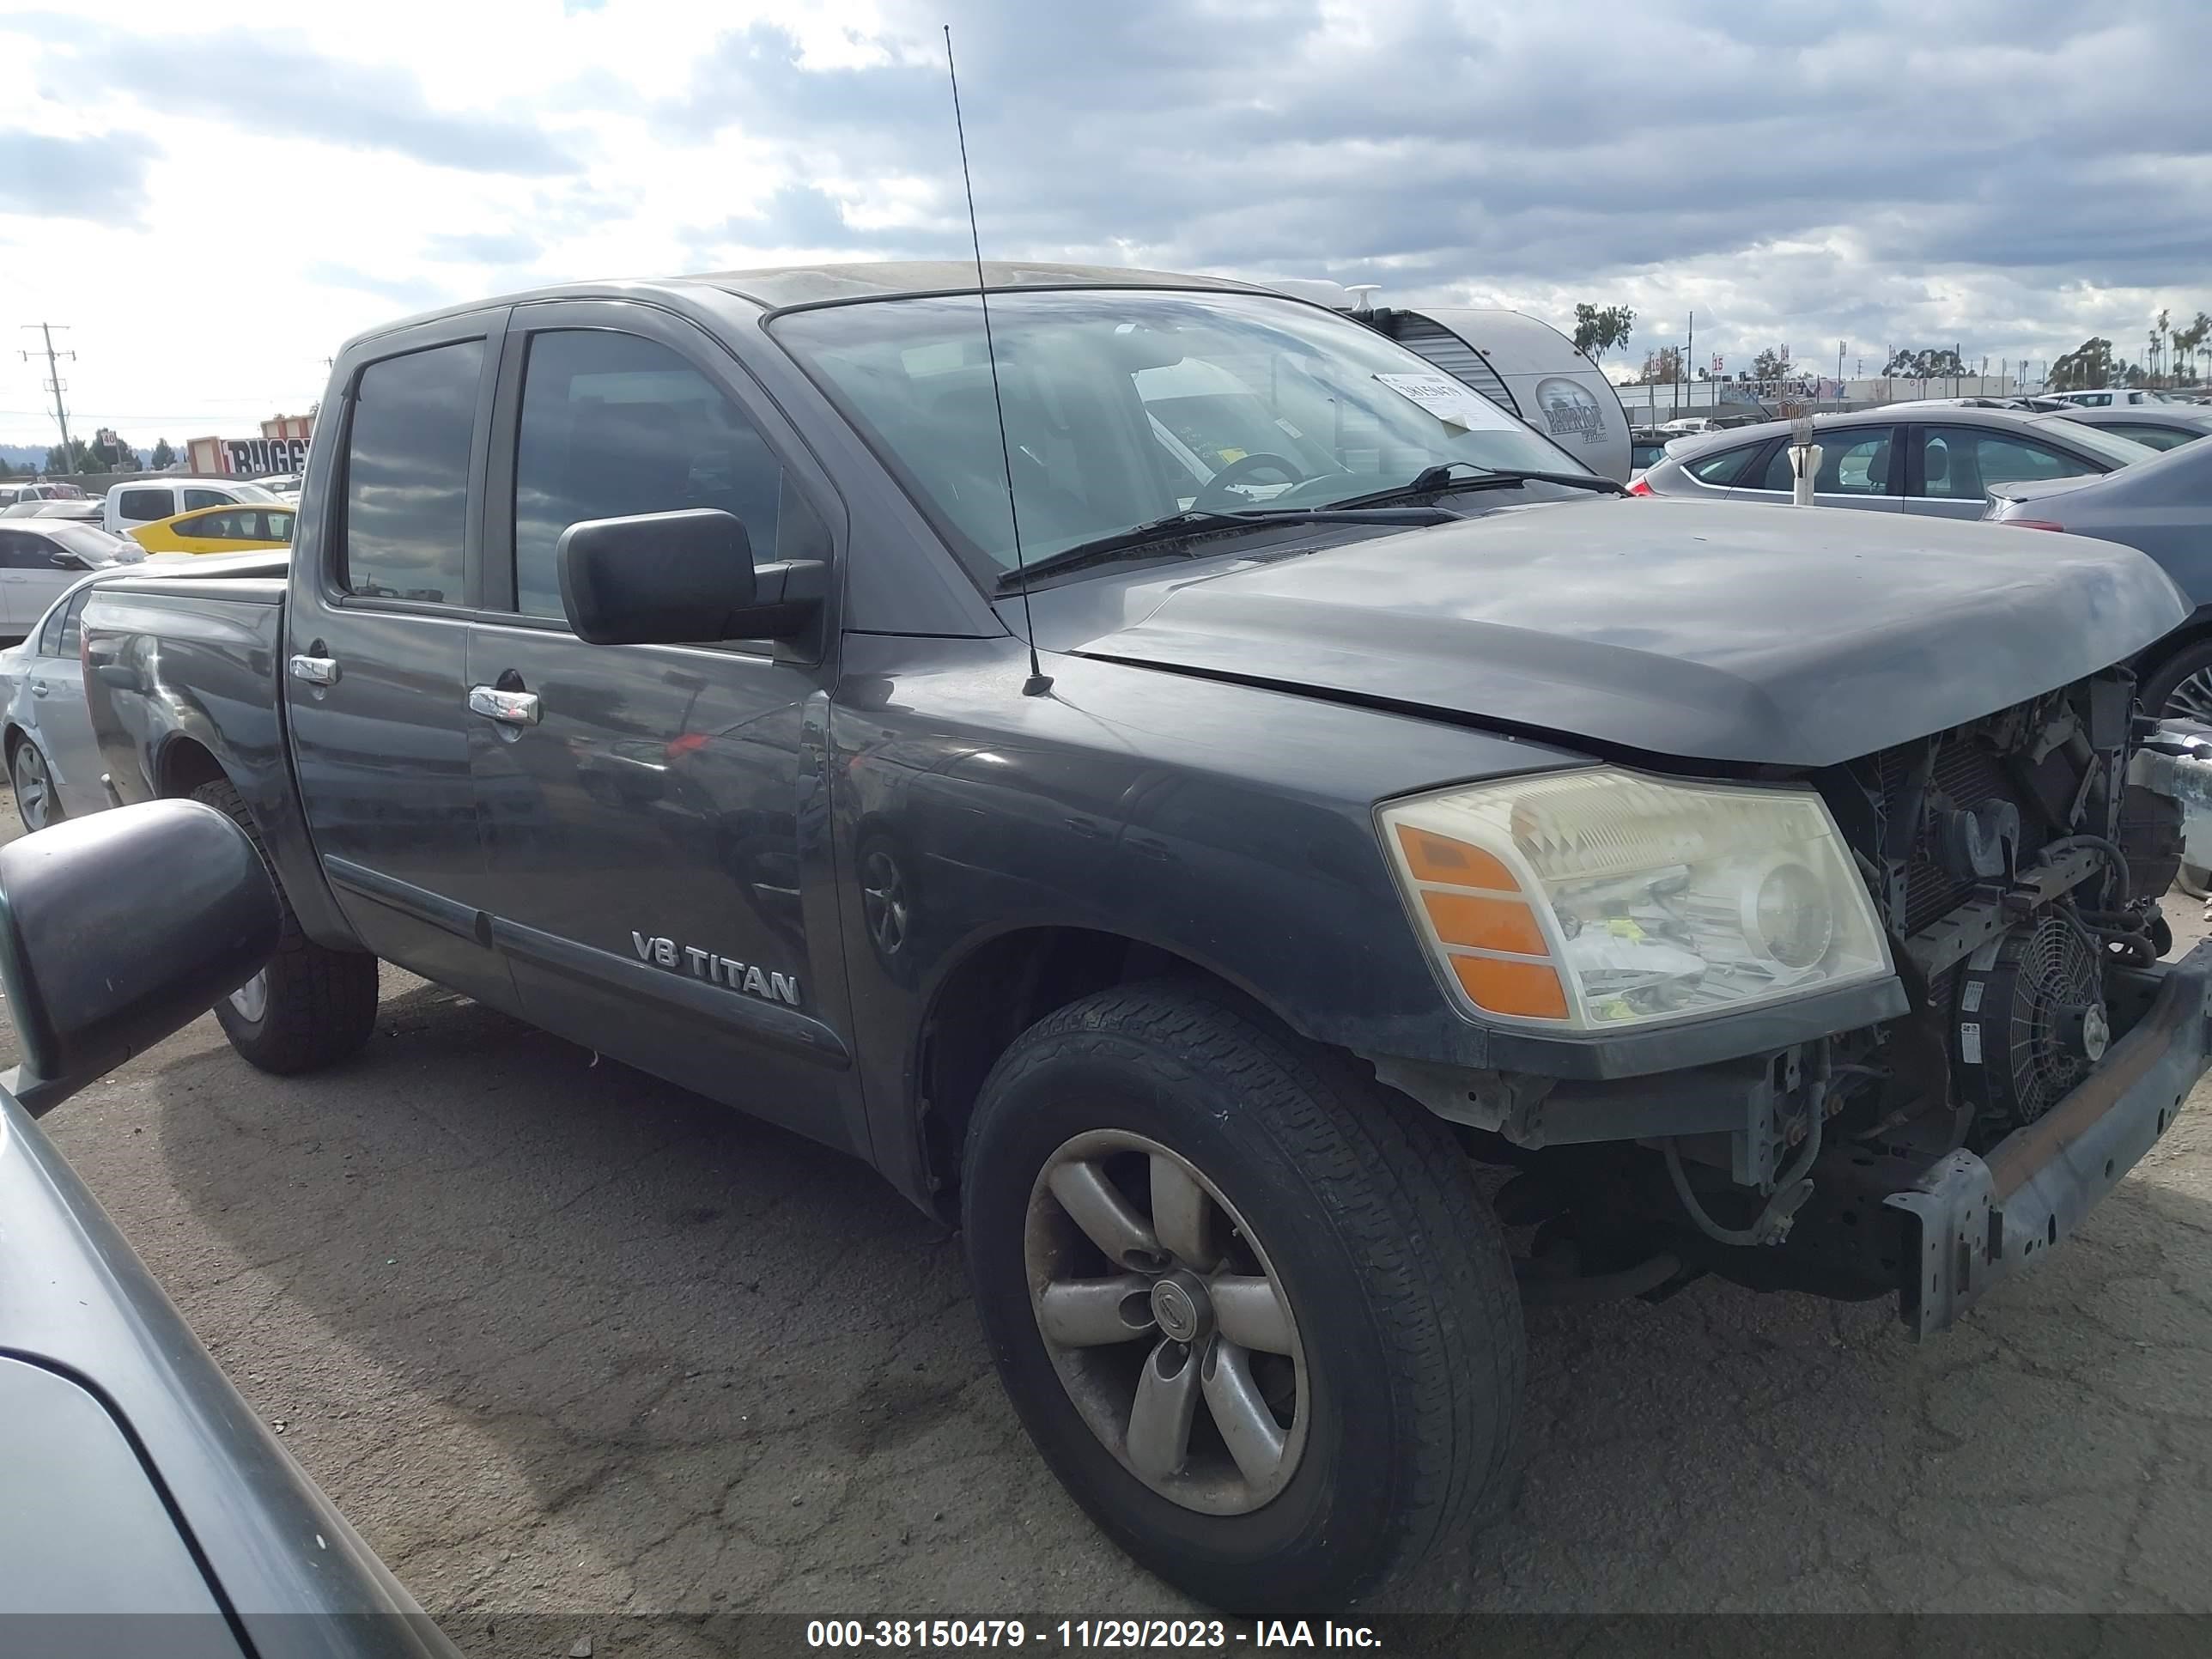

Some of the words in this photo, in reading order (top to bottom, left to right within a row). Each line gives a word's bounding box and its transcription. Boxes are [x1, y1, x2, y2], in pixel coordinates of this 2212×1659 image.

[1651, 356, 1661, 372] 16
[1713, 357, 1723, 370] 15
[1543, 404, 1605, 434] PATRIOT
[103, 434, 116, 444] 40
[1583, 432, 1607, 443] Edition
[632, 930, 680, 968] V8
[685, 945, 801, 1006] TITAN
